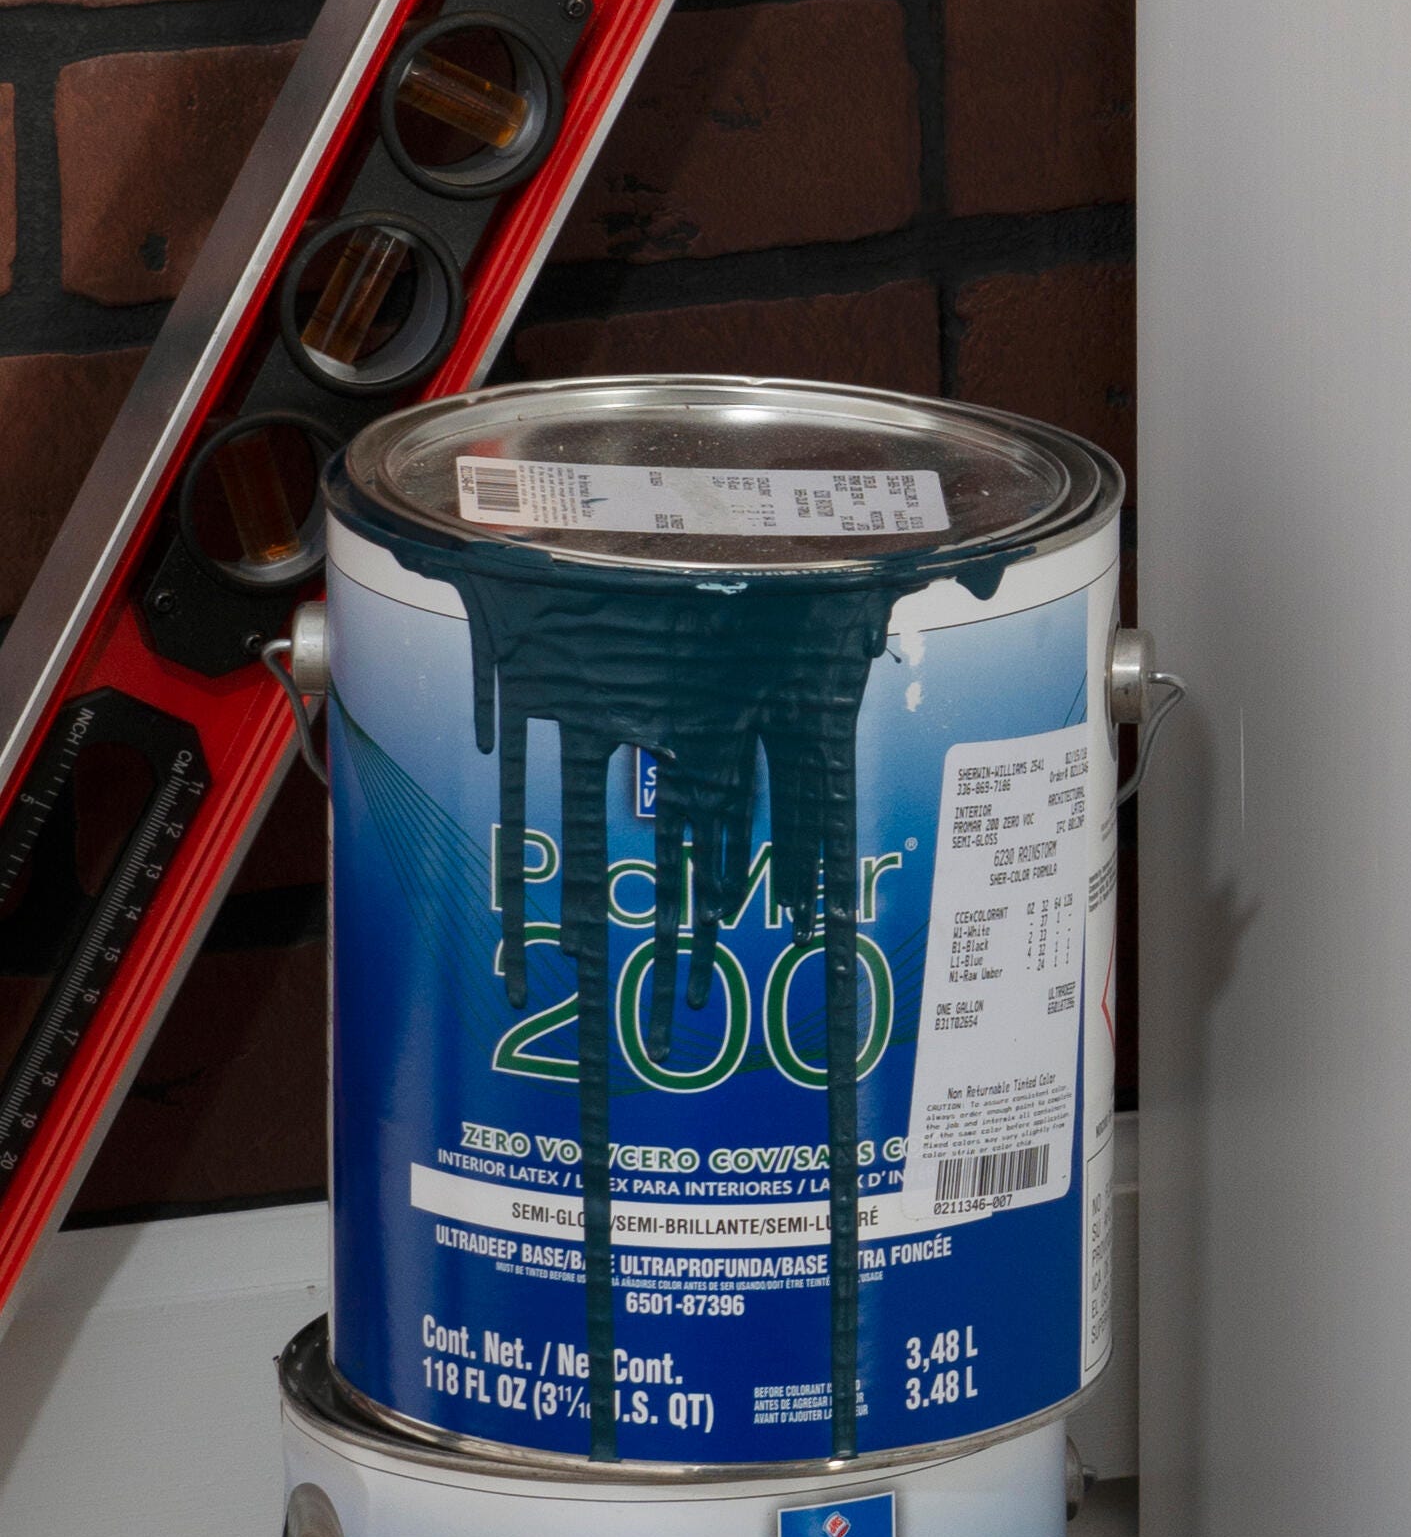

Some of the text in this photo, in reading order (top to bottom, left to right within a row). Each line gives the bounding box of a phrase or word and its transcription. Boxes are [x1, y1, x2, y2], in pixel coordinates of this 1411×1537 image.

[957, 761, 1028, 782] SHERWIN-WILLIAMS
[952, 812, 1036, 835] PROMAR 200 ZERO VOC
[954, 804, 993, 820] INTERIOR
[952, 833, 999, 849] SEMI-GLOSS
[993, 840, 1058, 867] 6230 RAINSTORM
[989, 863, 1058, 886] SHER-COLOR FORMULA
[951, 940, 989, 955] B1-Black
[950, 954, 984, 969] L1-Blue
[936, 999, 985, 1016] ONE GALLON
[947, 1087, 963, 1100] Non
[966, 1081, 1011, 1098] Returnable
[1013, 1076, 1037, 1092] Tinted
[460, 1121, 531, 1158] ZERO
[535, 1134, 700, 1174] VO/CERO
[708, 1139, 876, 1174] COV/SAS
[437, 1148, 506, 1178] INTERIOR
[509, 1163, 559, 1187] LATEX
[632, 1178, 681, 1197] PARA
[684, 1178, 793, 1198] INTERIORES
[933, 1194, 1013, 1215] 0211346-007
[435, 1223, 518, 1261] ULTRADEEP
[619, 1253, 828, 1280] ULTRAPROFUNDA/BASE
[891, 1233, 952, 1264] FONCÉE
[625, 1292, 745, 1316] 6501-87396
[422, 1314, 684, 1386] Cont. Net. Ne Cont.
[905, 1325, 979, 1374] 3,48 L
[422, 1356, 715, 1434] 118 FL OZ QT)
[753, 1383, 826, 1399] BEFORE COLORANT
[905, 1370, 961, 1412] 3.48
[966, 1365, 979, 1399] L
[753, 1396, 829, 1411] ANTES DE AGREGAR
[753, 1411, 779, 1425] AVANT
